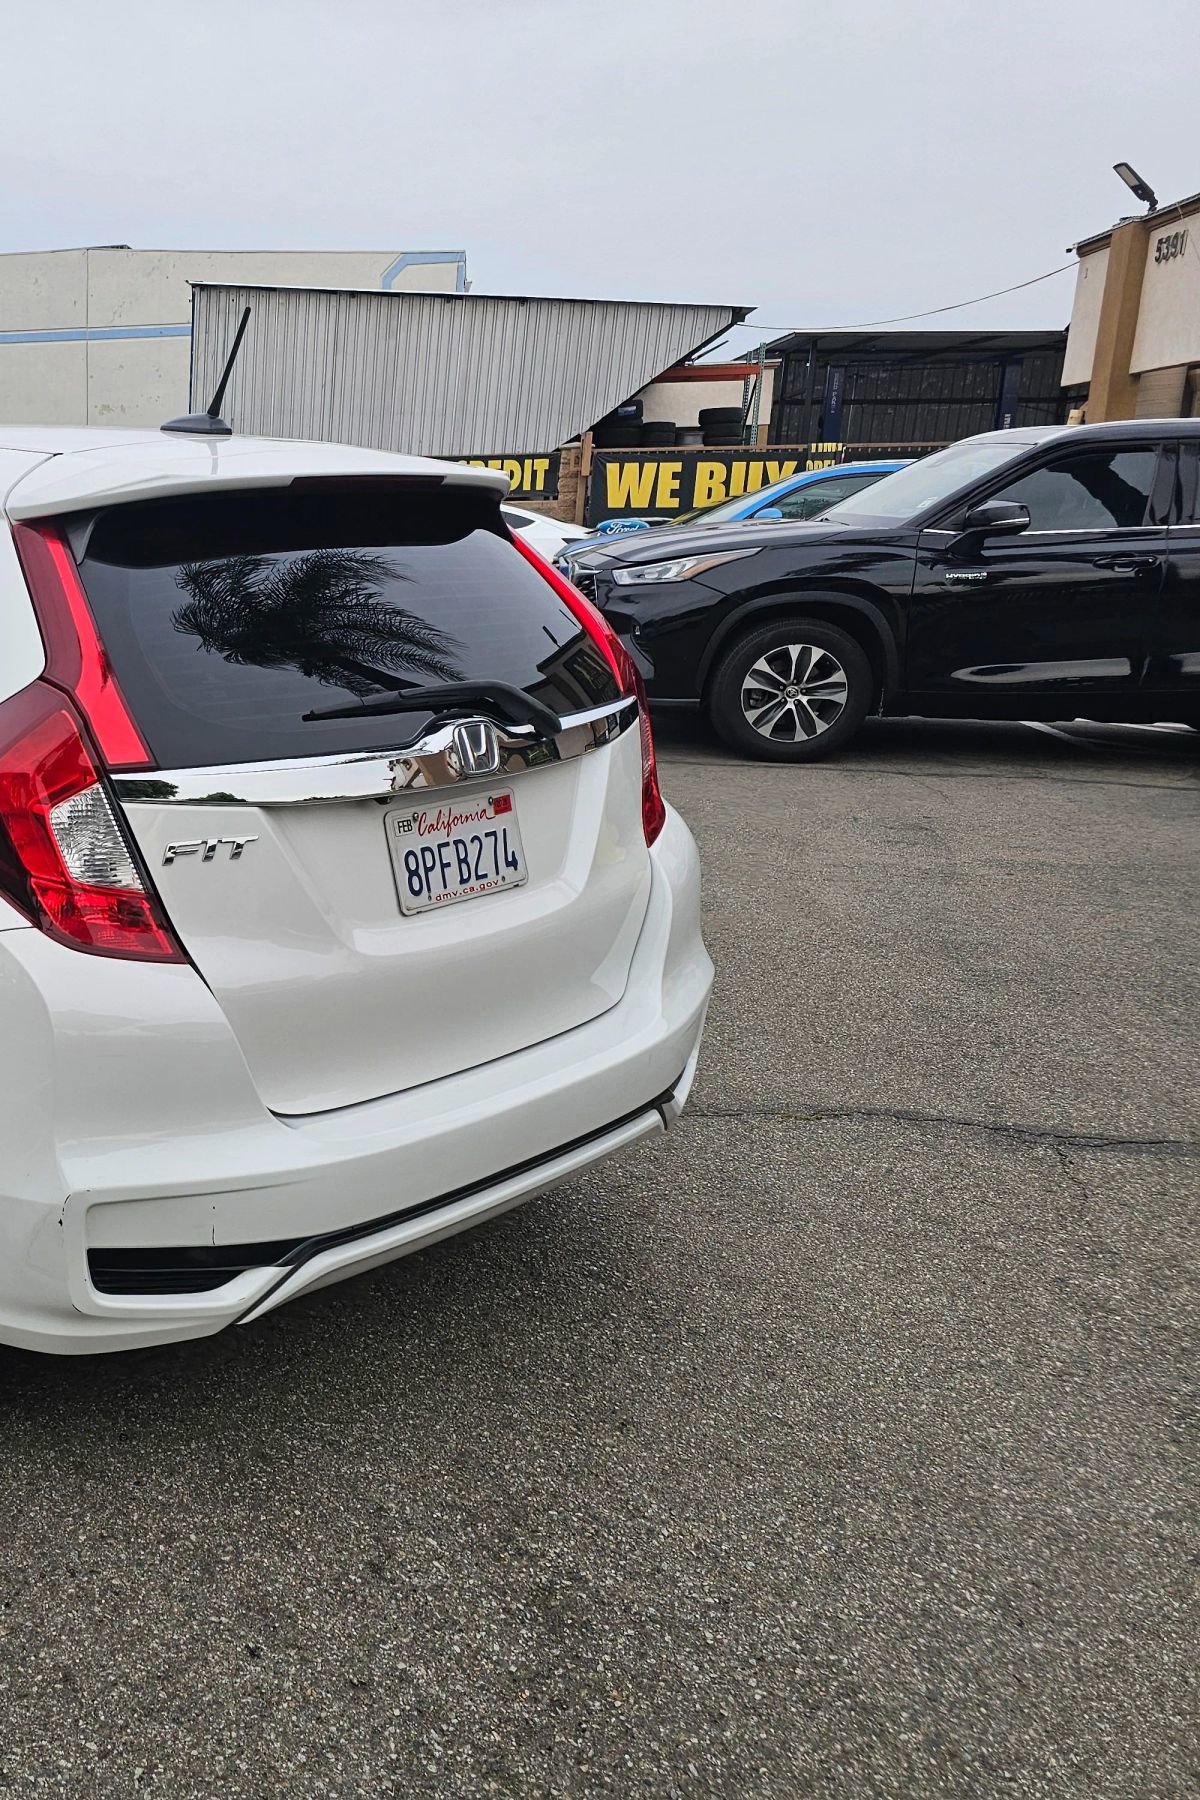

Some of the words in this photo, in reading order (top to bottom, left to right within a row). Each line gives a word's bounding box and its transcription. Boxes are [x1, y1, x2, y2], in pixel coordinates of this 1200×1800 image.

[1155, 229, 1189, 264] 5391
[606, 462, 683, 509] WE
[397, 819, 413, 834] FEB
[417, 803, 495, 838] California
[162, 835, 259, 866] FIT
[404, 828, 518, 897] 8PFB274
[435, 880, 499, 902] dmv.ca.gov
